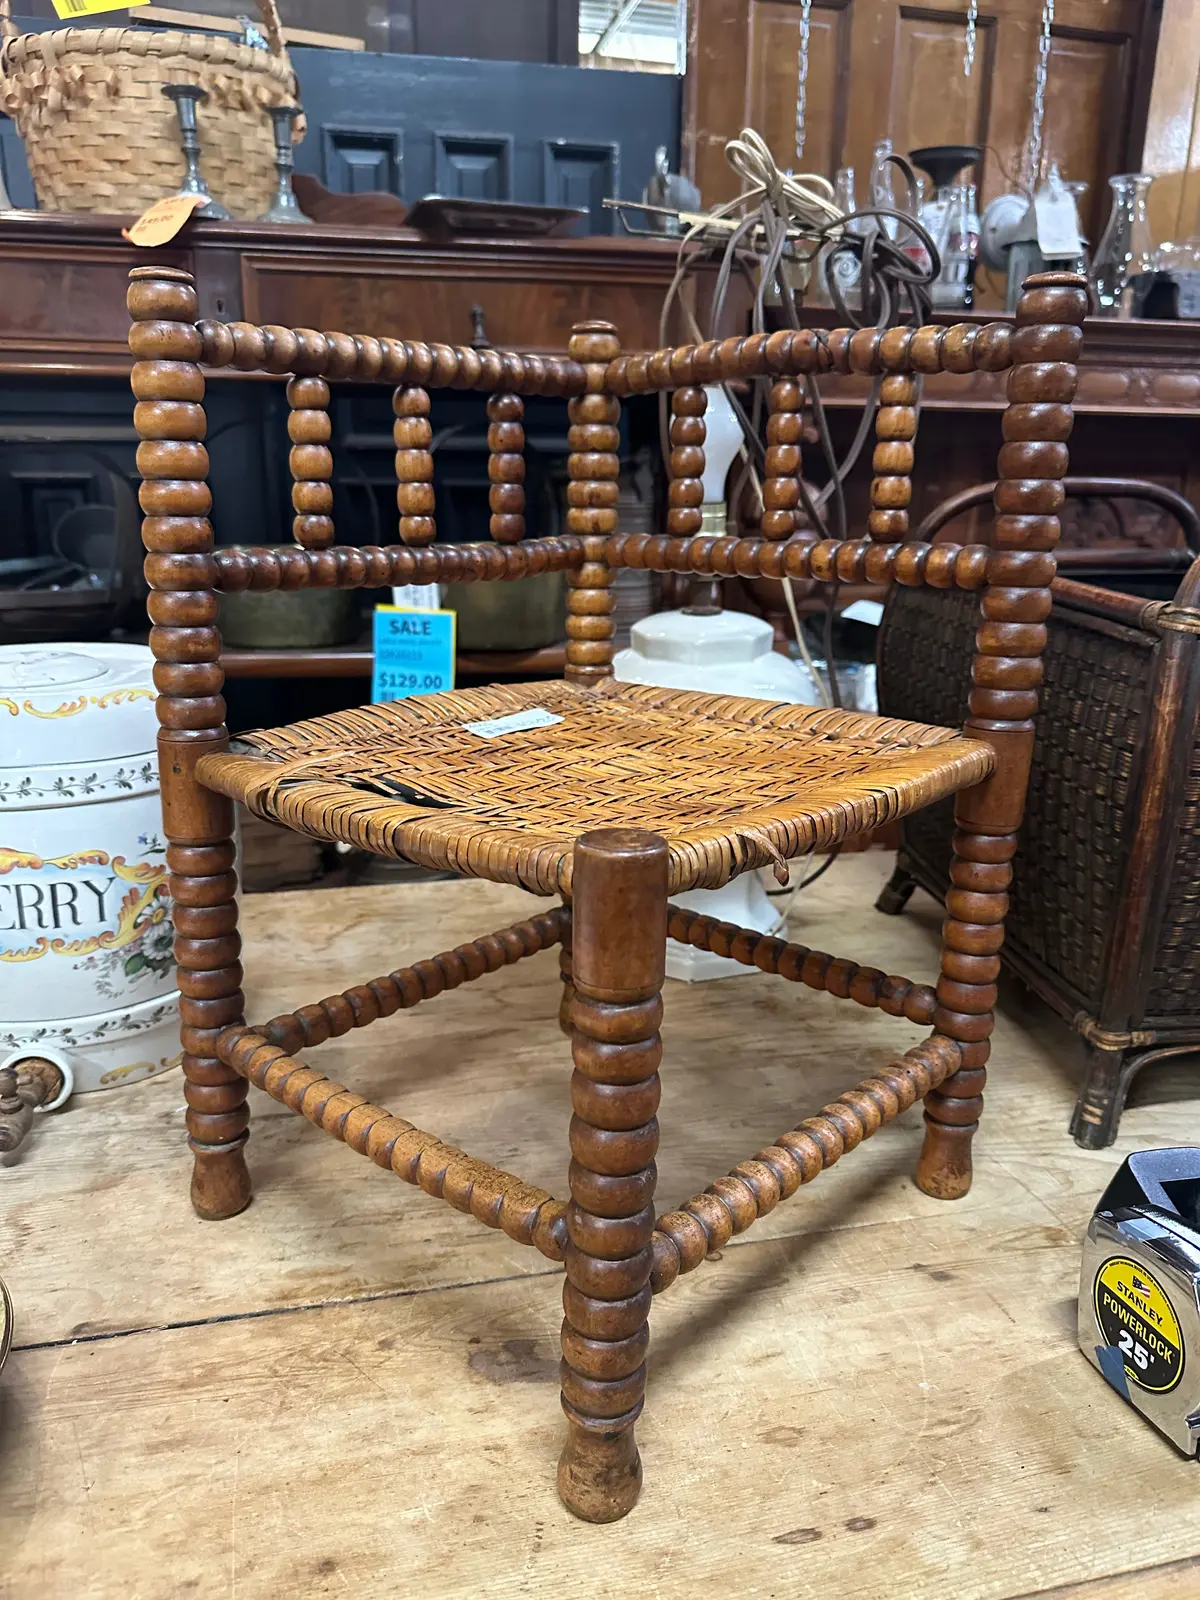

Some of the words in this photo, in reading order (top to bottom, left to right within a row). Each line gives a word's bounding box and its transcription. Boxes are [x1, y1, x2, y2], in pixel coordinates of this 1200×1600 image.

[389, 619, 432, 636] SALE
[379, 672, 443, 689] $129.00
[1116, 1280, 1163, 1326] STANLEY
[1104, 1292, 1173, 1365] POWERLOCK
[1117, 1329, 1155, 1370] 25'
